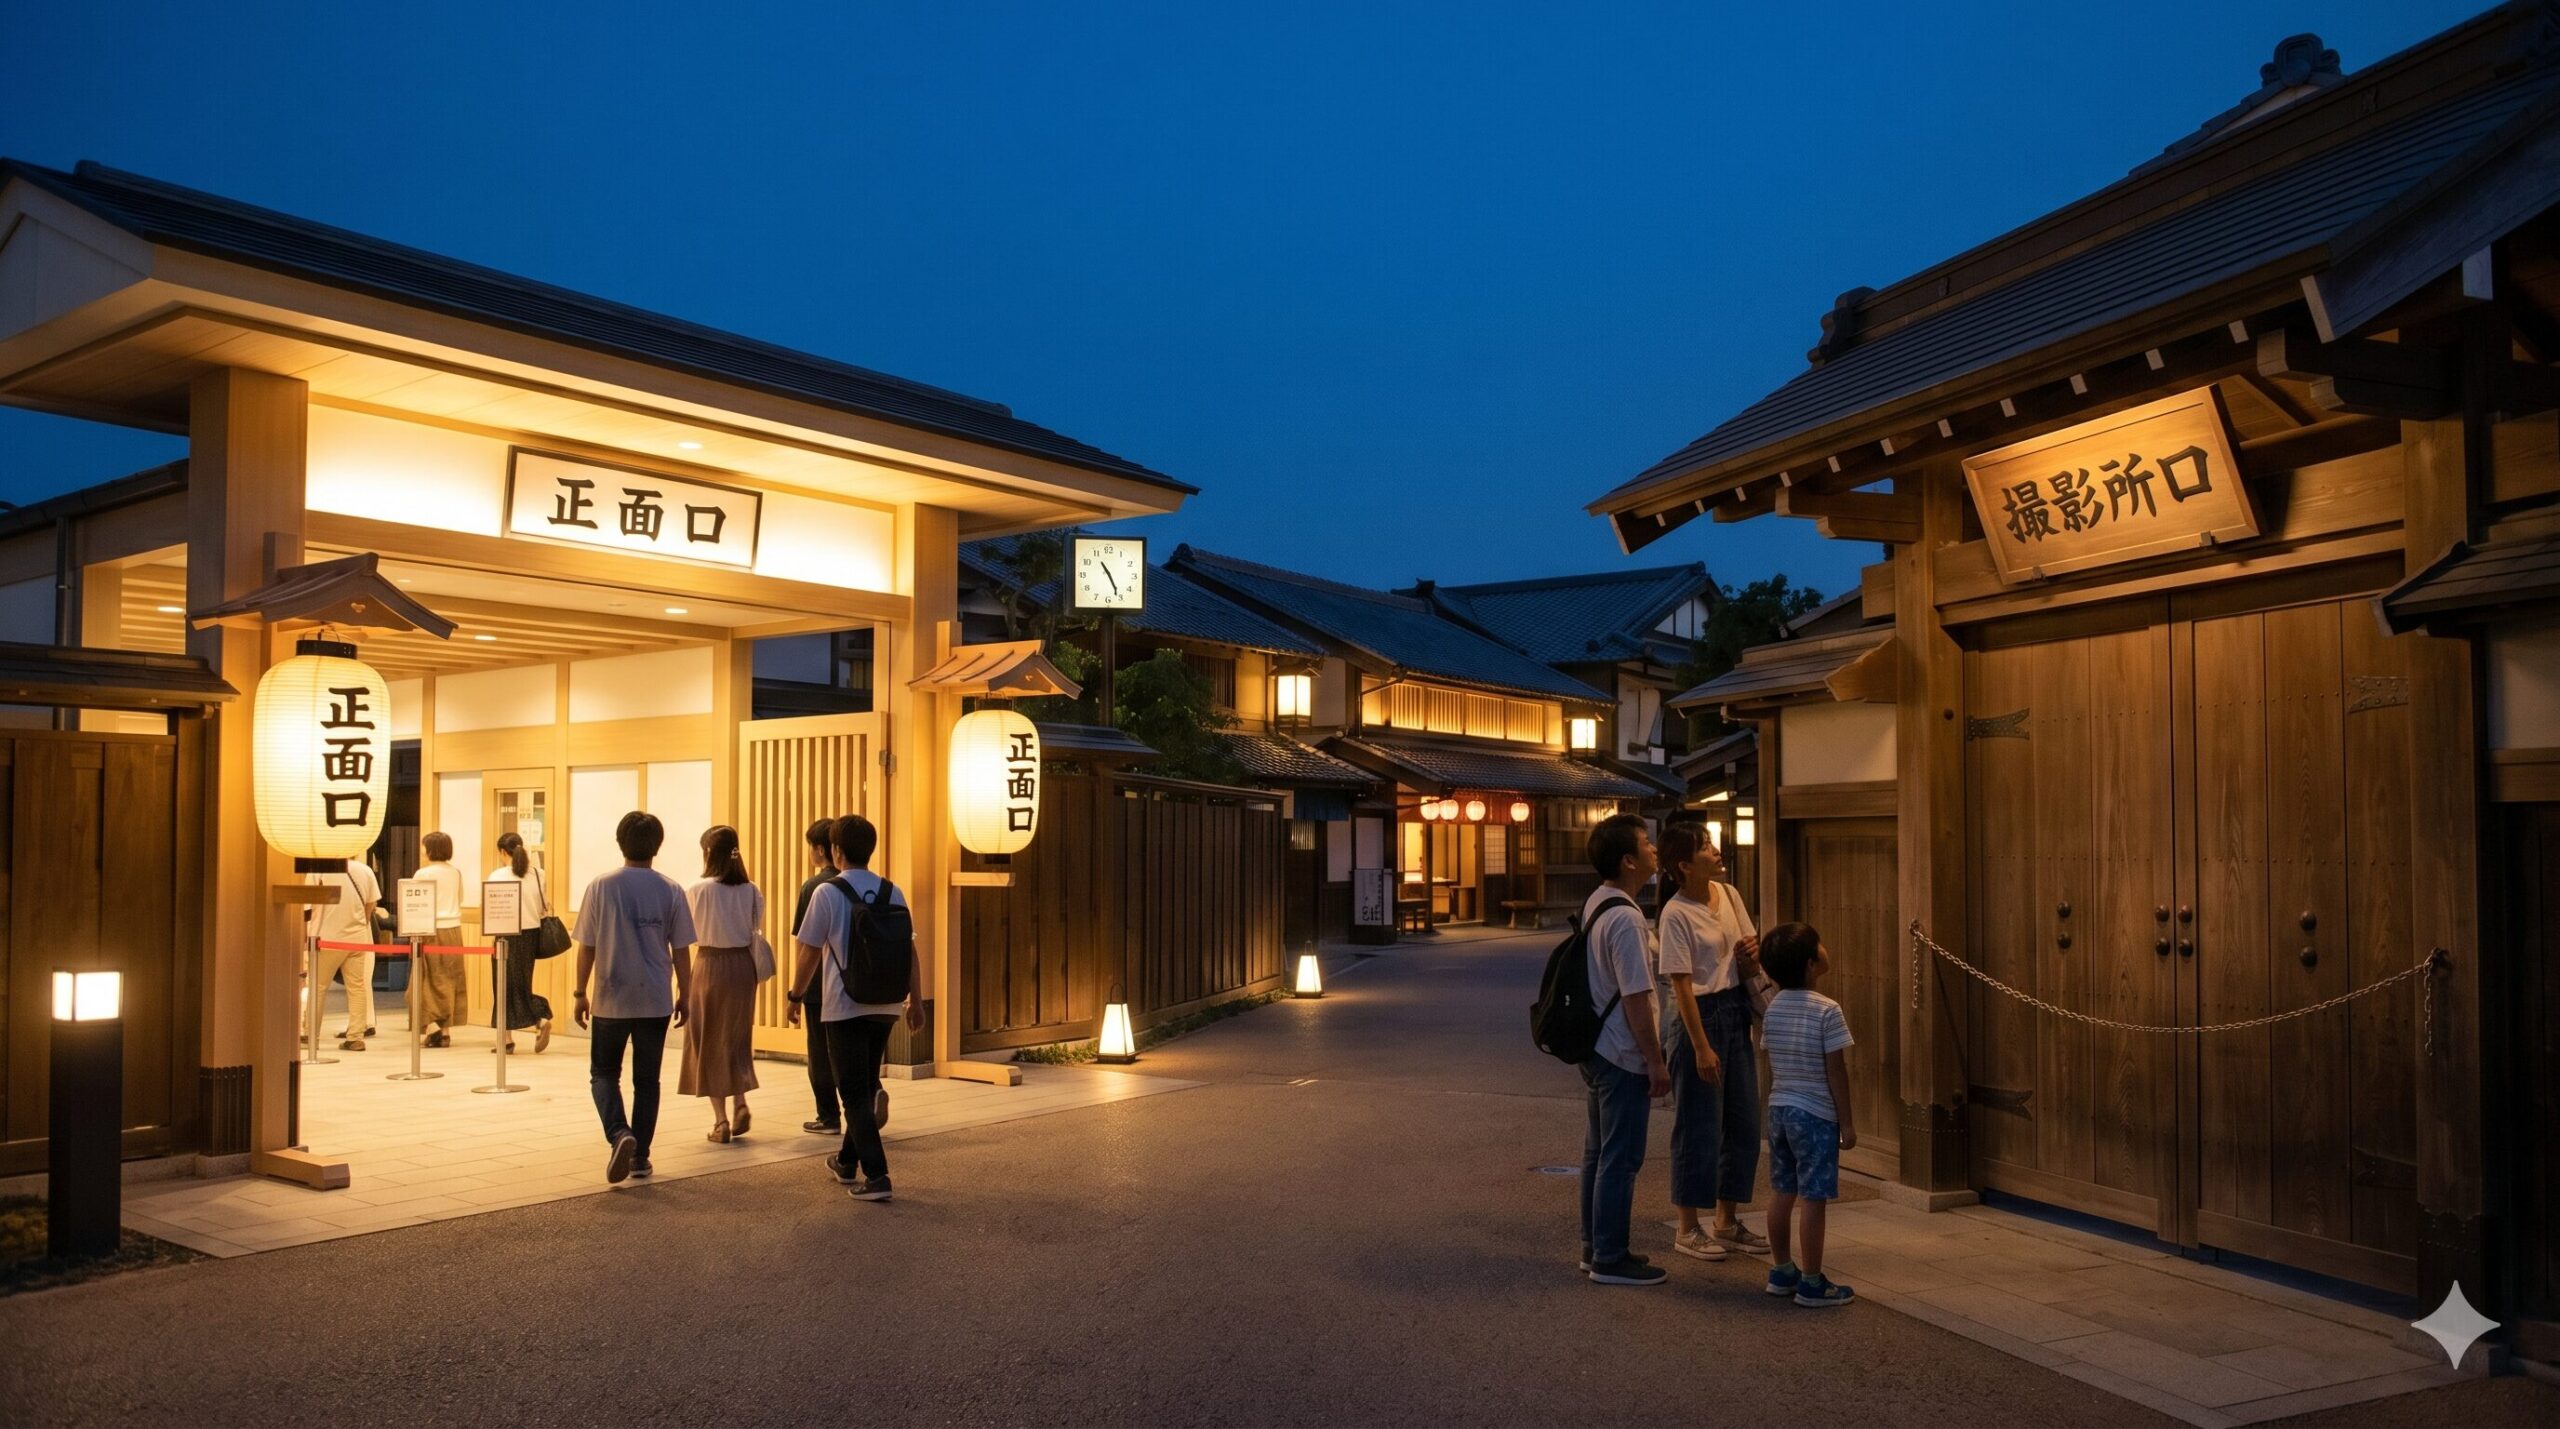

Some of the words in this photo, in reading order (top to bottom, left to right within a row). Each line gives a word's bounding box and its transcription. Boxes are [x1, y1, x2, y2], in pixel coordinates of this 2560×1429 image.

[547, 477, 728, 544] 正面口
[2001, 445, 2213, 544] 撮影所口
[1127, 560, 1133, 568] 2
[320, 686, 375, 828] 正面口
[1006, 732, 1037, 832] 正面口
